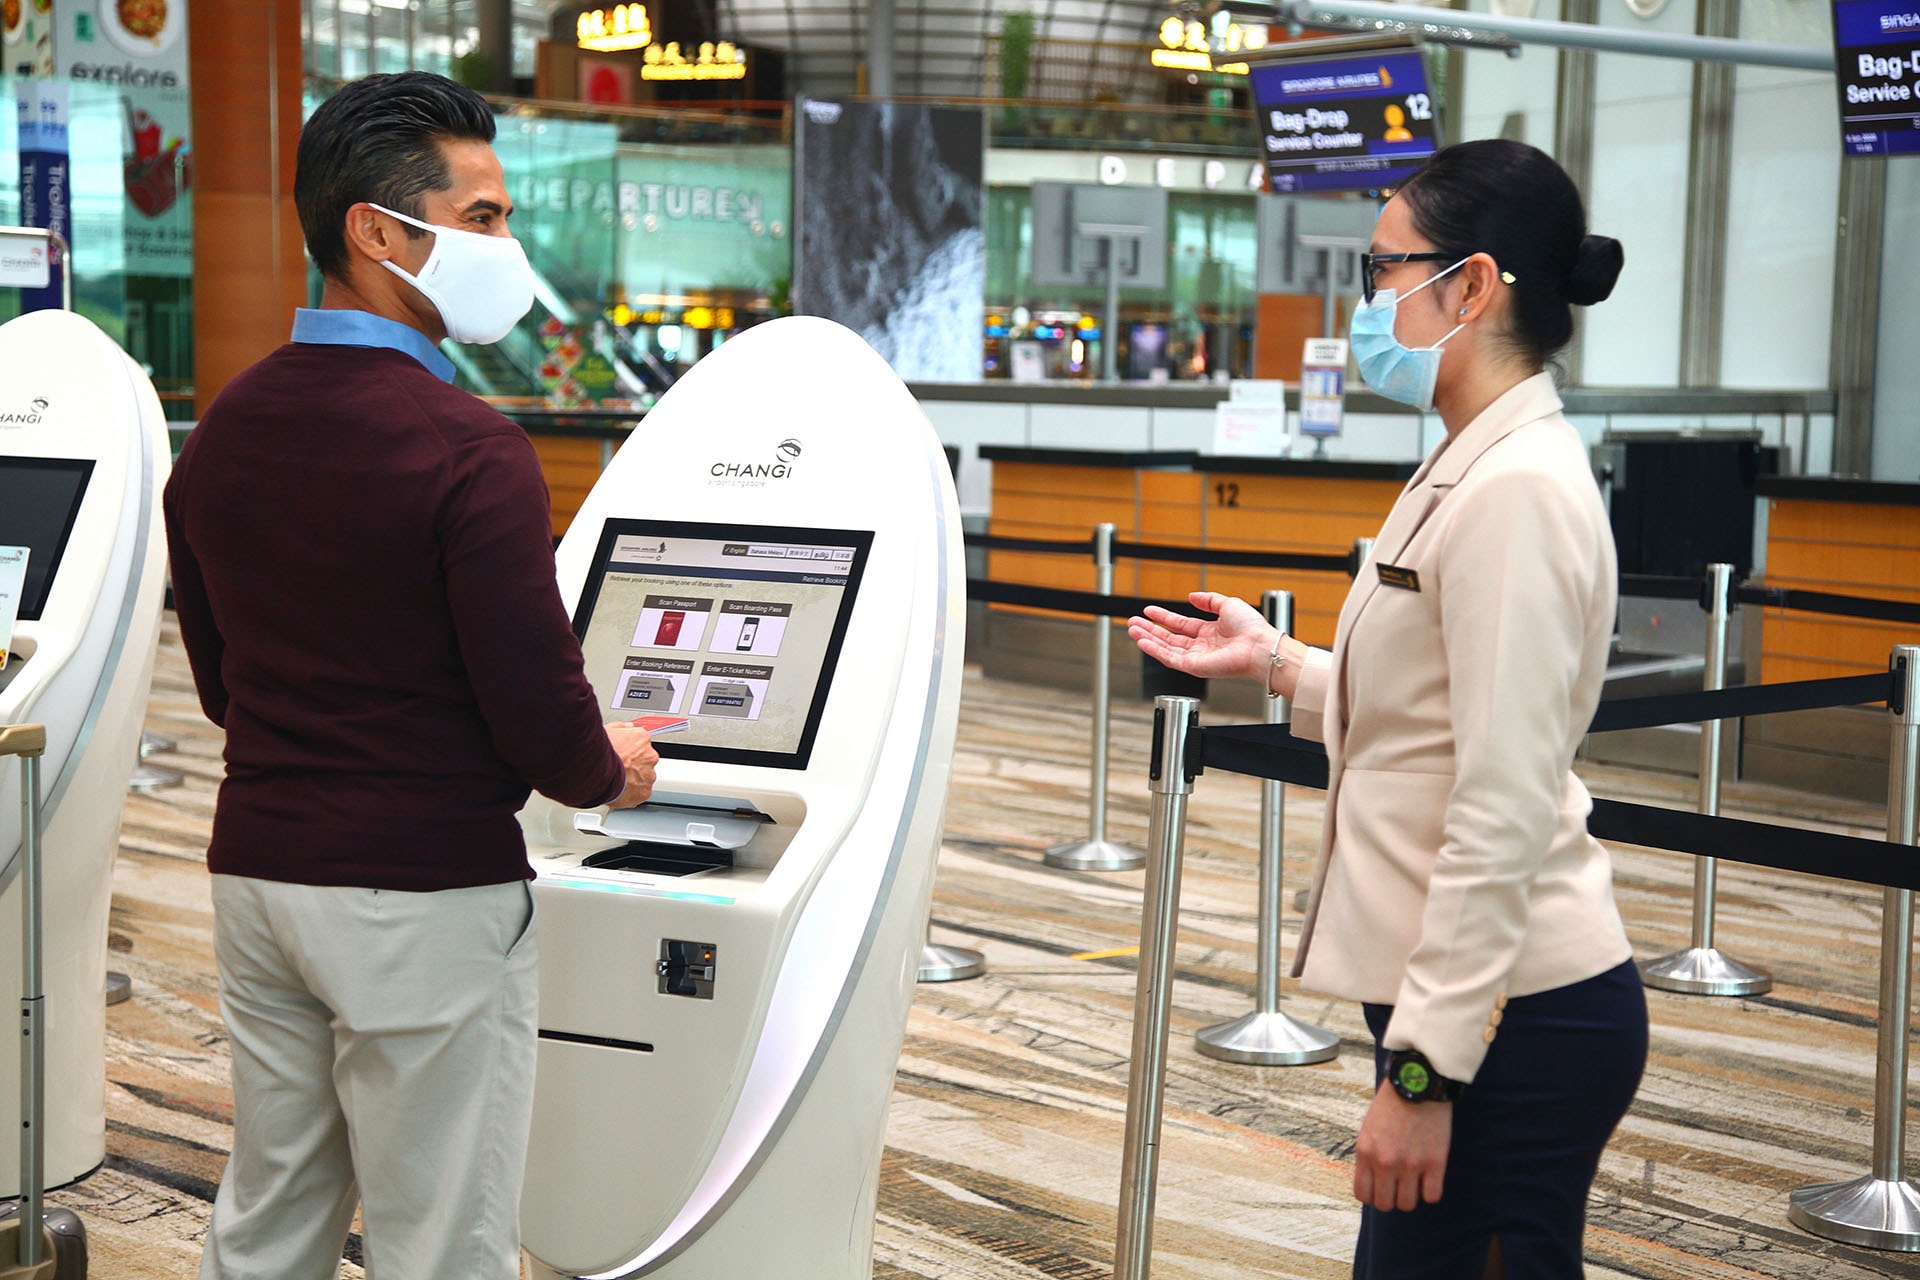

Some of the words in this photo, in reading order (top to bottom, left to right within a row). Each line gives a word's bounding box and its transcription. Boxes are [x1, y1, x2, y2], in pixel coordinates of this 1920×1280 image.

[1847, 83, 1910, 103] Service
[1405, 93, 1432, 120] 12
[1270, 108, 1349, 134] Bag-Drop
[1266, 135, 1312, 152] Service
[1312, 131, 1364, 149] Counter
[711, 462, 792, 479] CHANGI
[1216, 482, 1240, 508] 12
[644, 577, 664, 585] booking
[803, 575, 824, 583] Retrieve
[825, 577, 847, 585] Booking
[673, 600, 697, 608] Passport
[729, 603, 743, 611] Scan
[743, 604, 768, 613] Boarding
[626, 659, 640, 667] Enter
[640, 660, 663, 670] Booking
[664, 662, 691, 670] Reference
[706, 665, 722, 673] Enter
[722, 666, 745, 675] E-Ticket
[745, 668, 768, 676] Number
